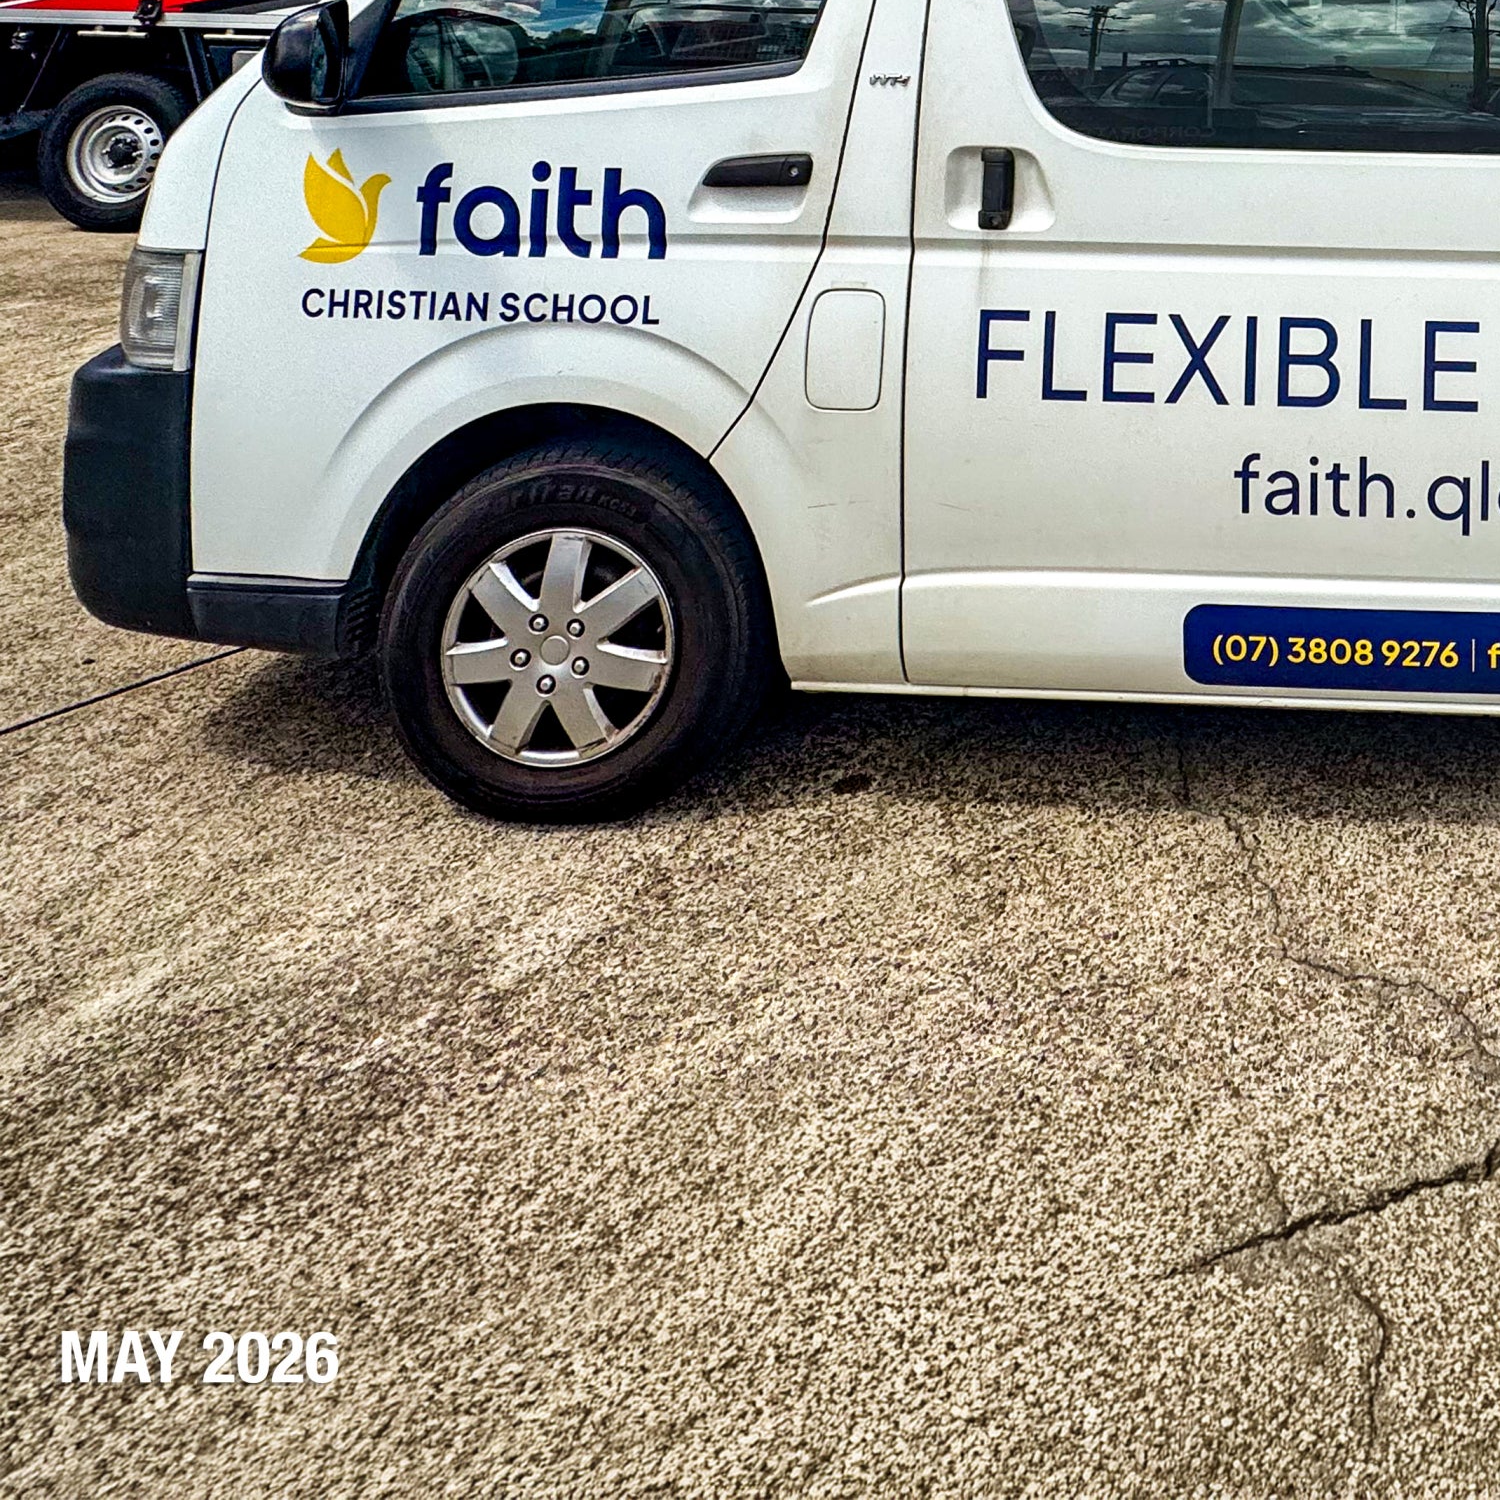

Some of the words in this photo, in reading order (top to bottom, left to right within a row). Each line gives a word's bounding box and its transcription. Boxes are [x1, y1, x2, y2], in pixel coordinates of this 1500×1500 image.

[416, 160, 667, 260] faith
[302, 288, 489, 321] CHRISTIAN
[499, 292, 660, 325] SCHOOL
[976, 308, 1480, 414] FLEXIBLE
[1211, 634, 1279, 668] (07)
[1287, 637, 1373, 667] 3808
[1381, 639, 1459, 668] 9276
